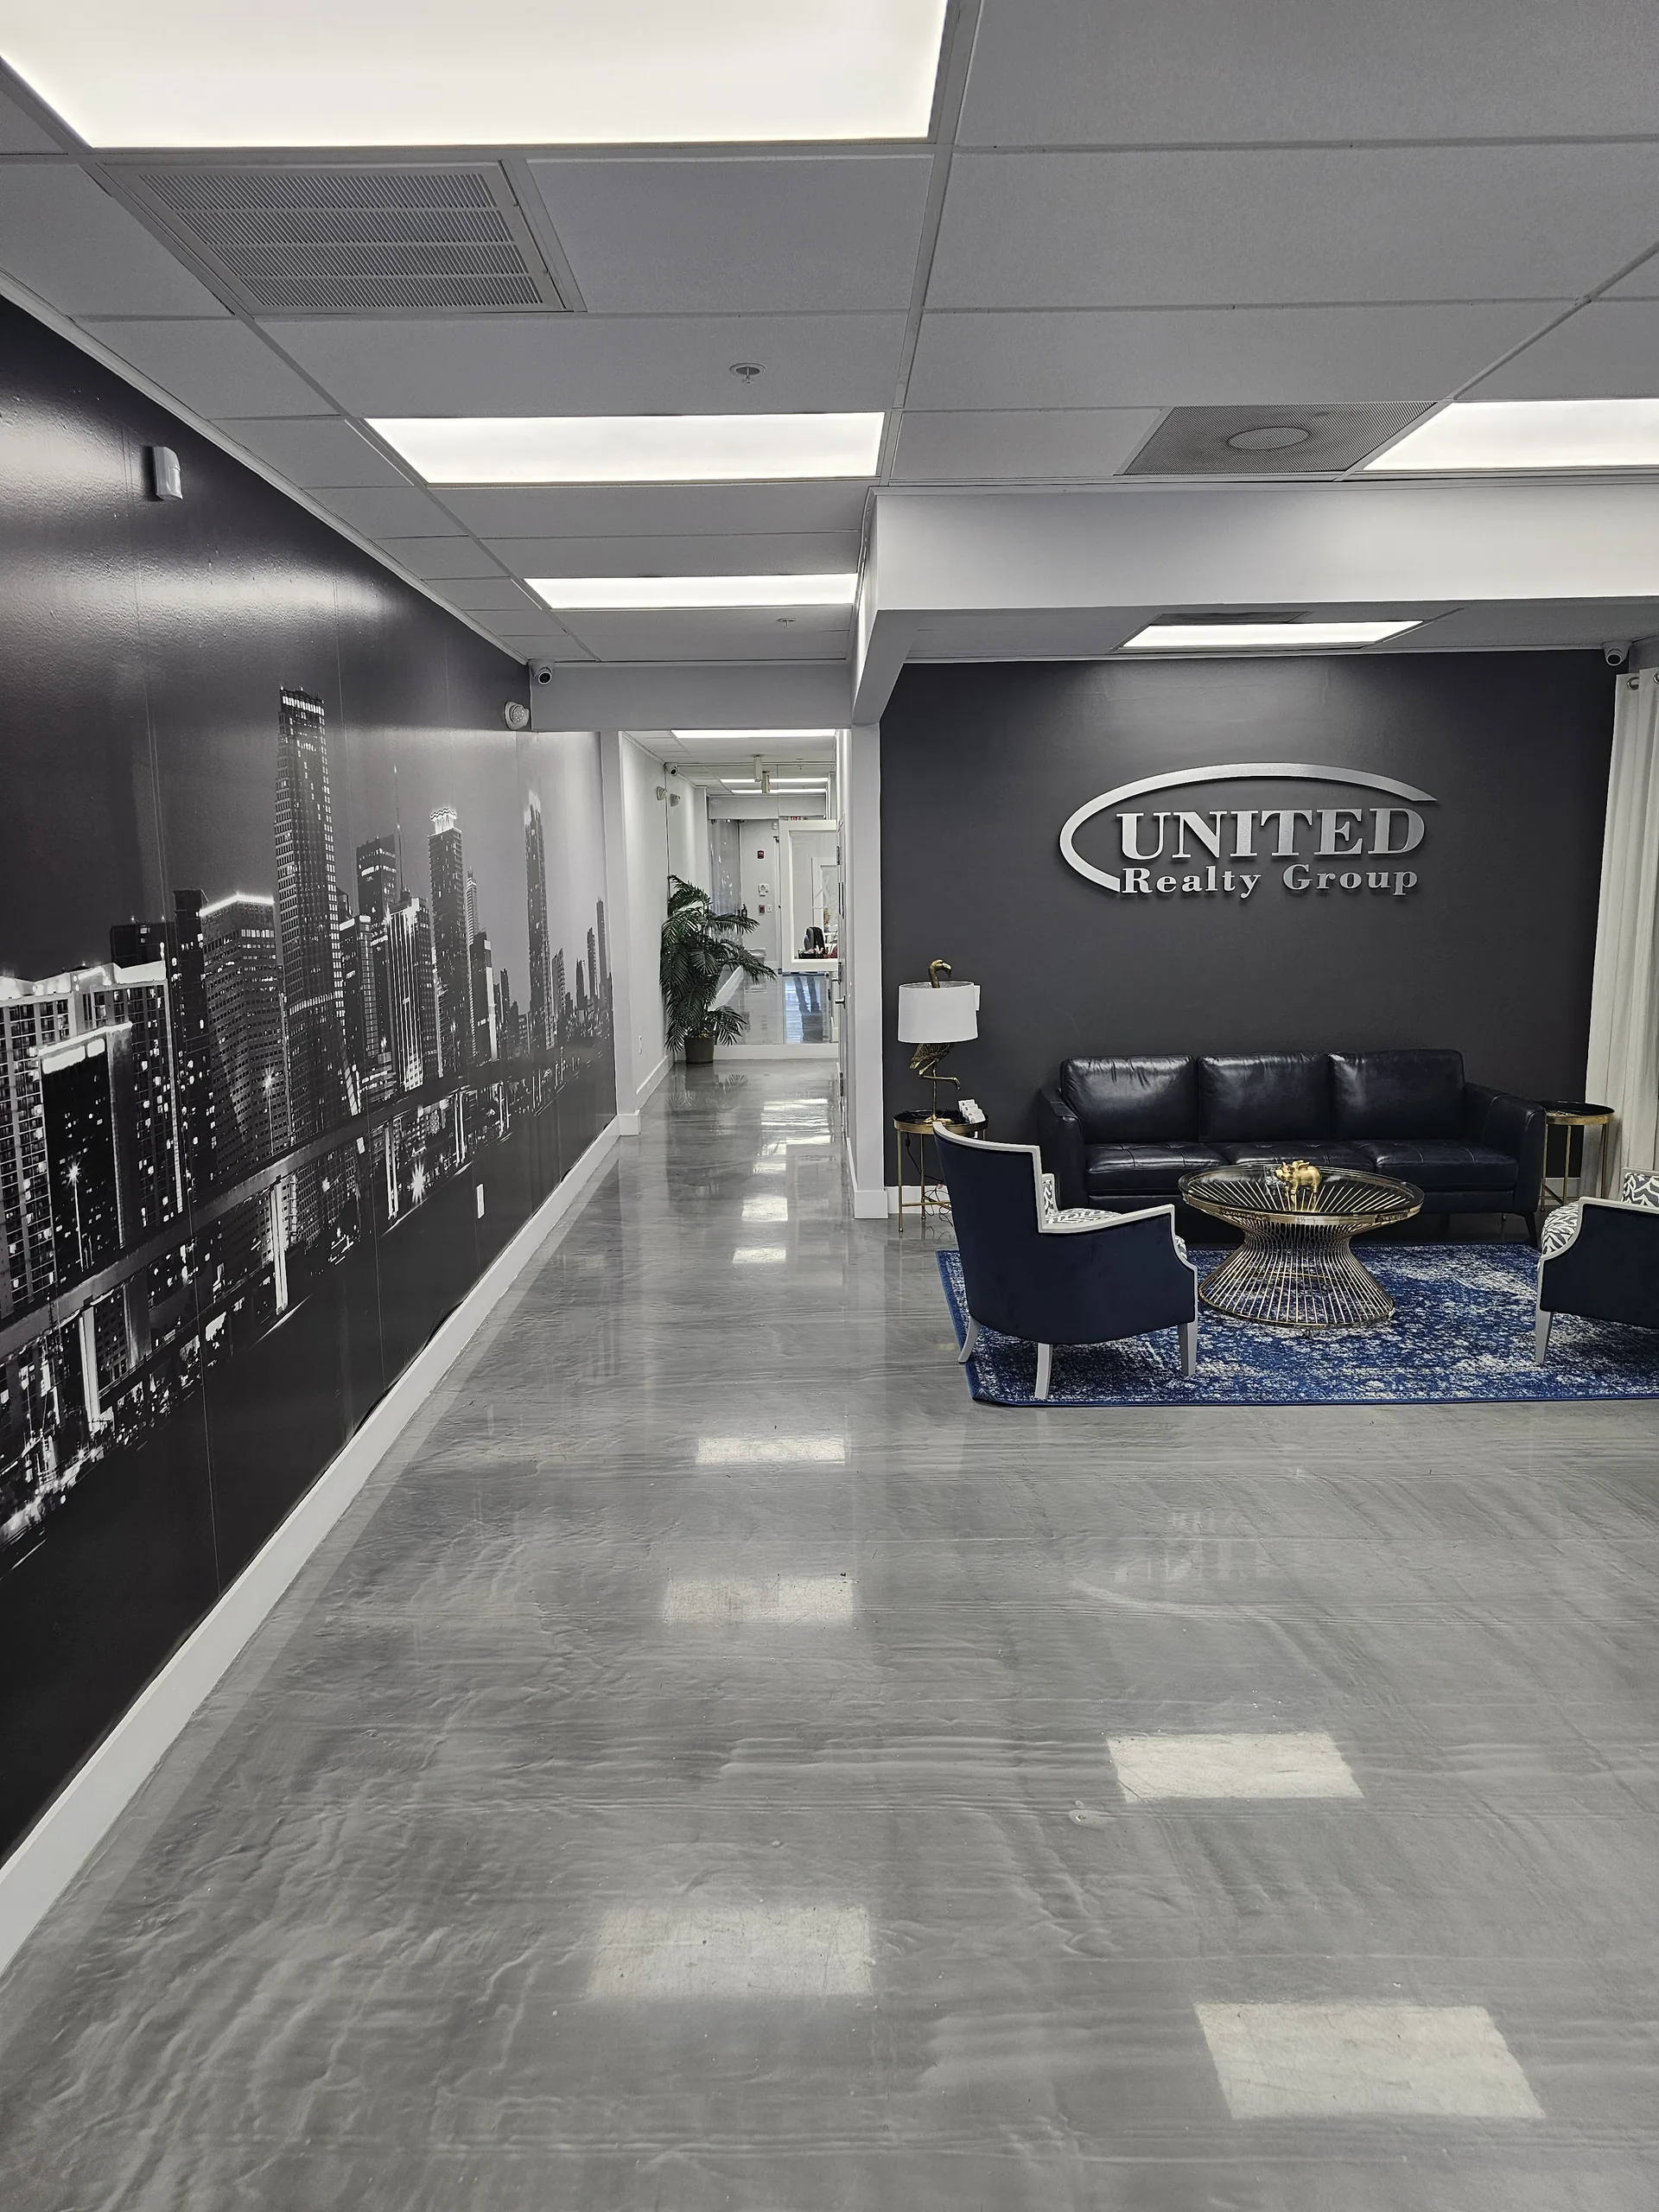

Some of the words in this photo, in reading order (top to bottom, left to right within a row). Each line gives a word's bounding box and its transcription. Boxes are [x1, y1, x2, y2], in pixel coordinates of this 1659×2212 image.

[1116, 808, 1425, 861] UNITED
[1122, 865, 1262, 899] Realty
[1282, 864, 1418, 896] Group
